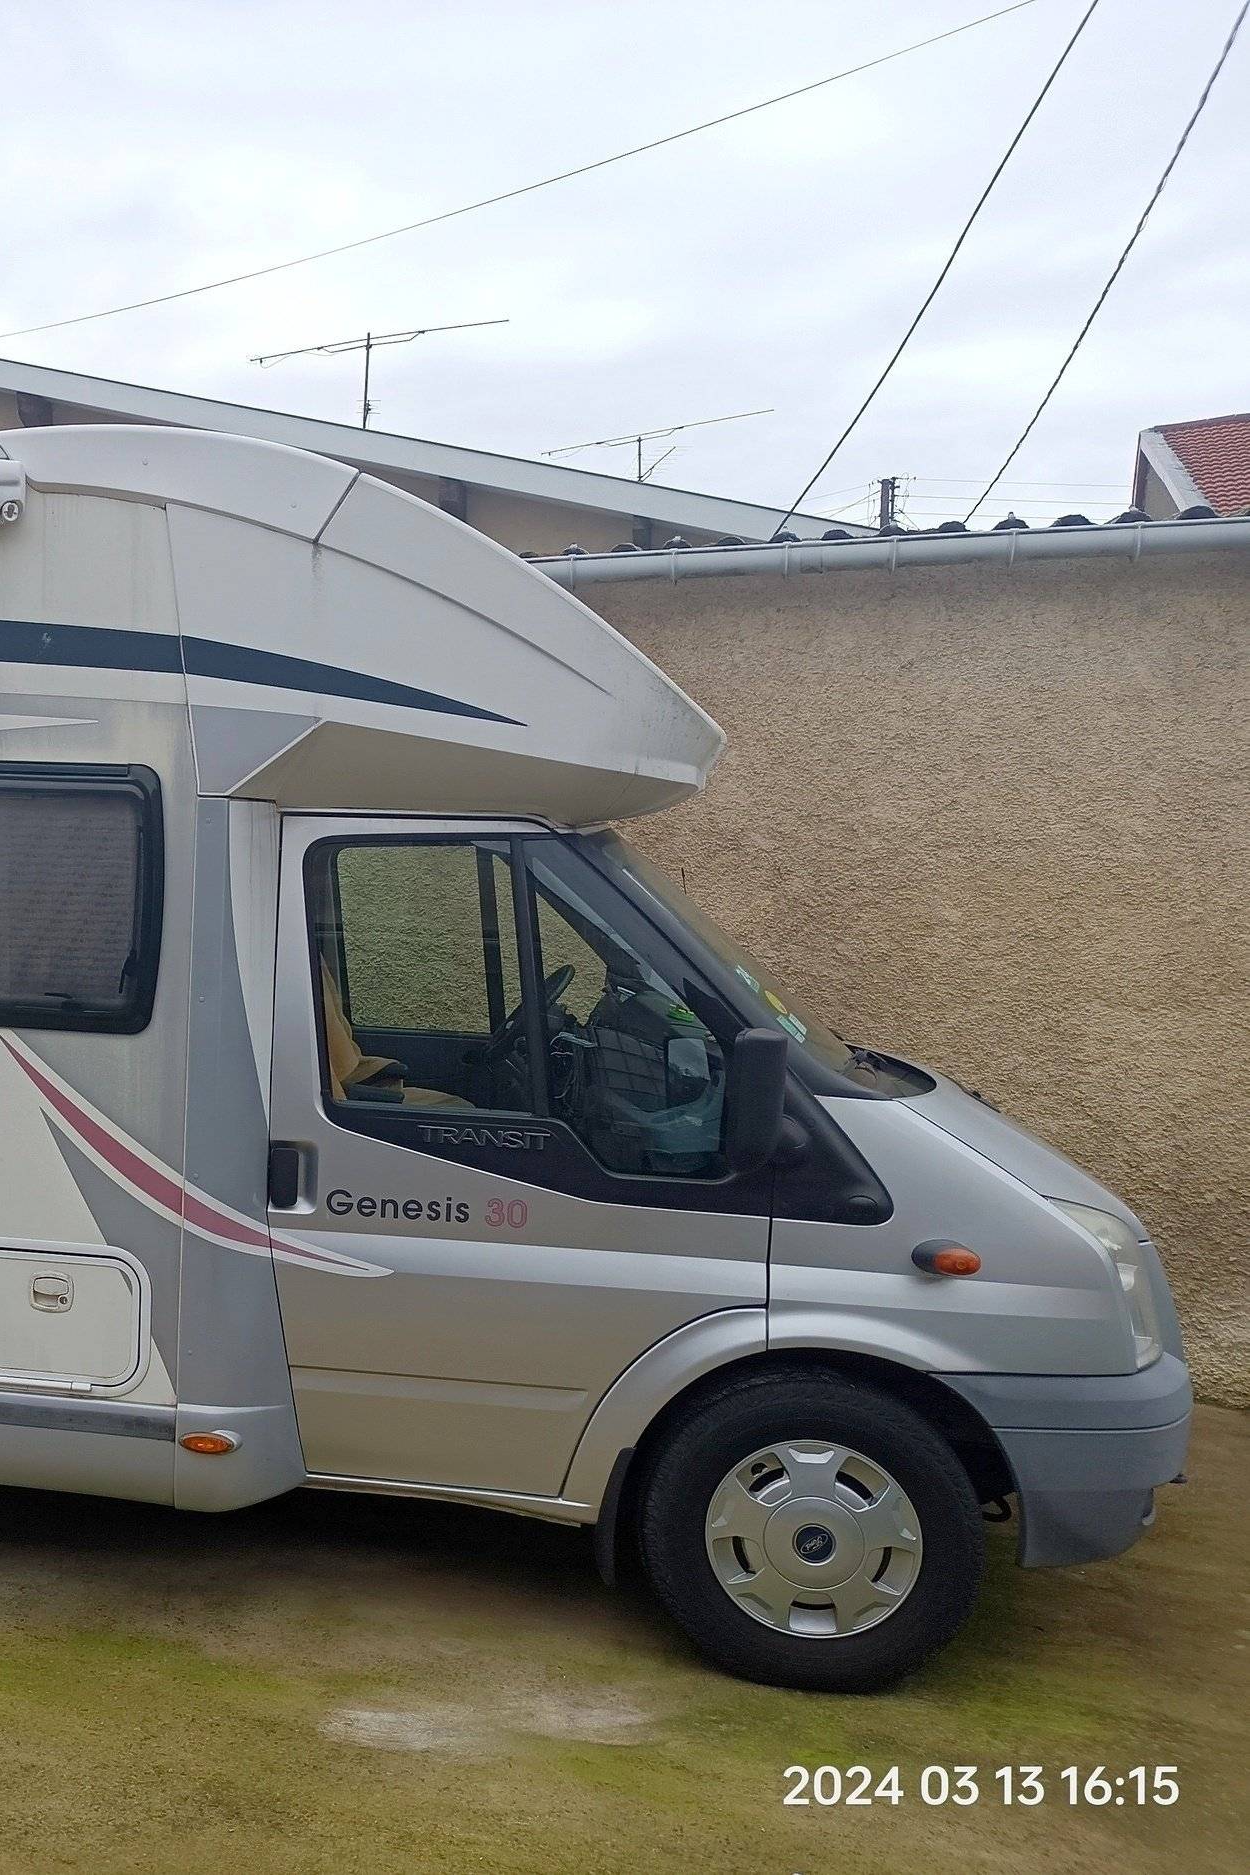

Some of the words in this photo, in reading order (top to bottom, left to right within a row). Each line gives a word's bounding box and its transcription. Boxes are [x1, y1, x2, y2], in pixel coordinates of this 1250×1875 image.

[417, 1125, 551, 1150] TRANSIT
[326, 1189, 469, 1223] Genesis
[484, 1198, 529, 1229] 30
